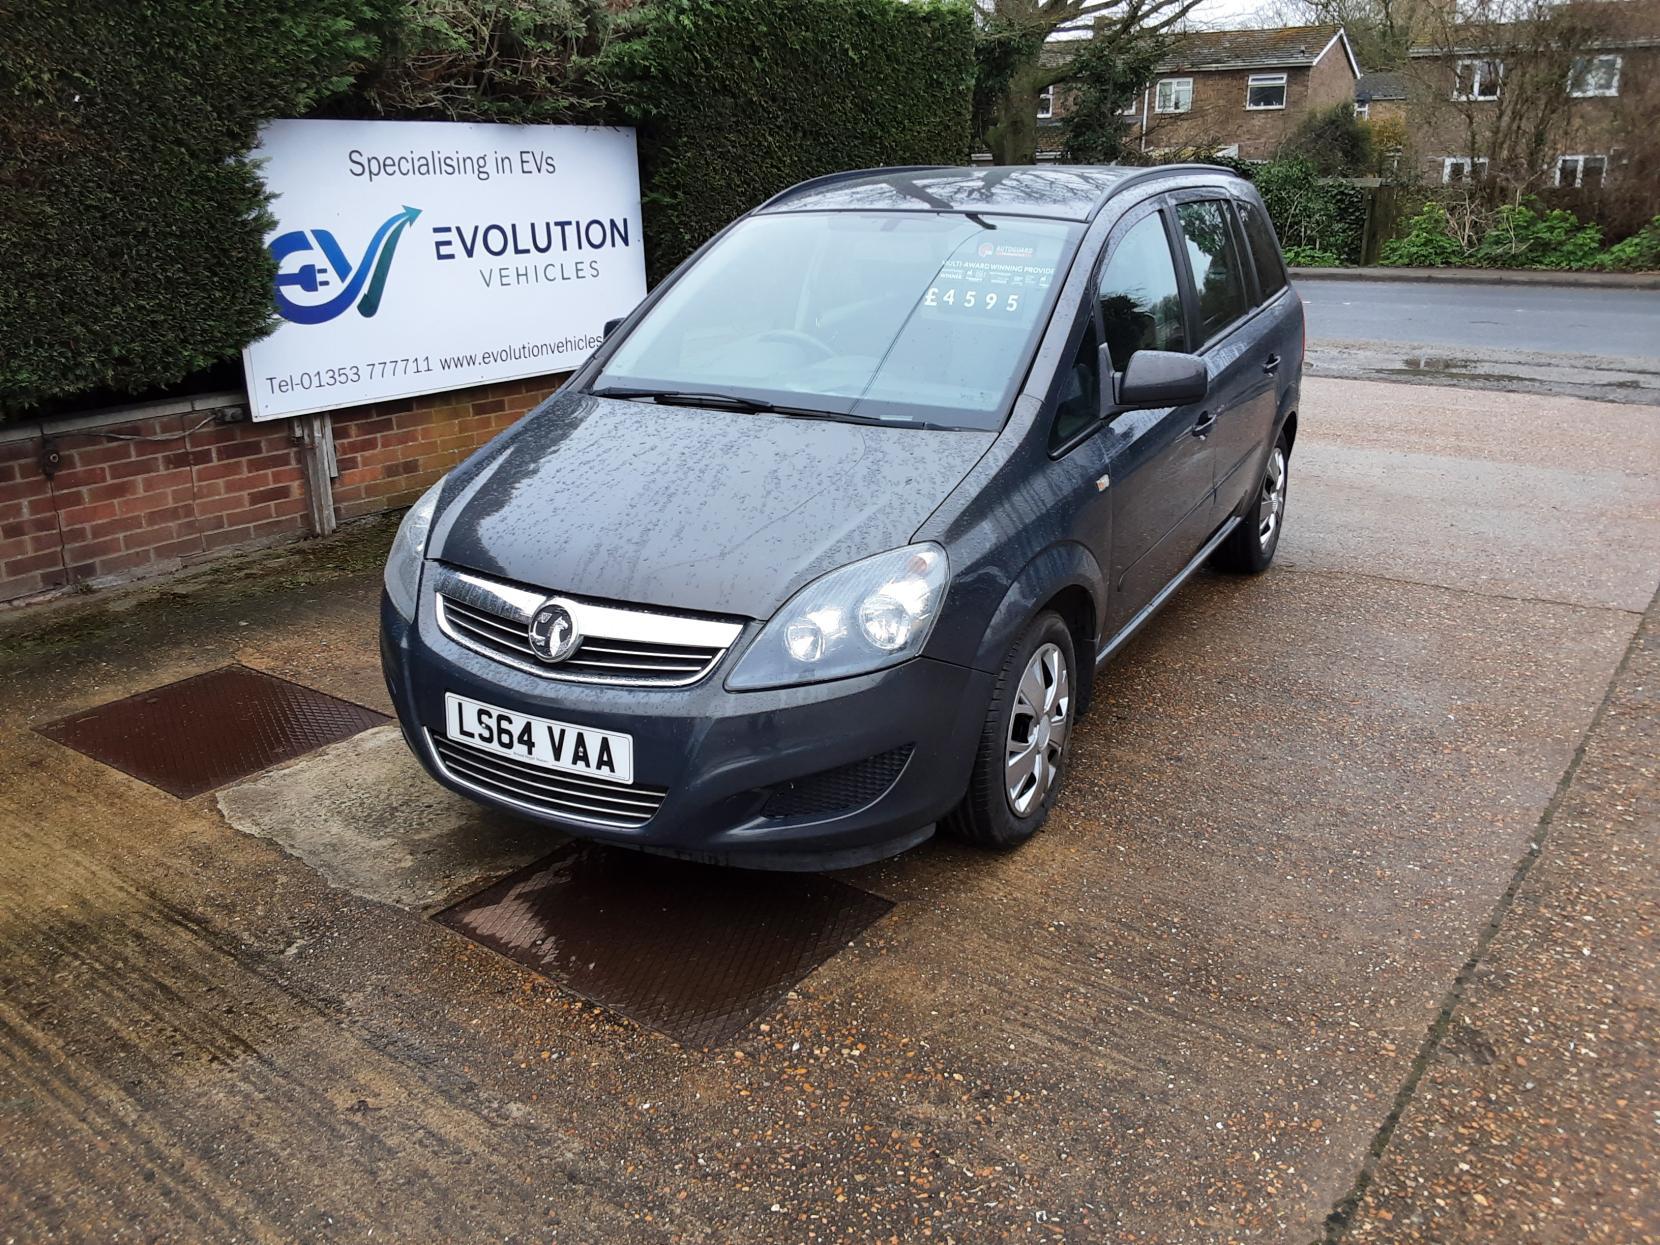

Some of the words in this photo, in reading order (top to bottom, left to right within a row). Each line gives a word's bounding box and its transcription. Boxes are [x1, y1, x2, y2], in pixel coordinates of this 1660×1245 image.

[348, 149, 489, 182] Specialising
[495, 151, 513, 175] in
[520, 150, 556, 175] EVs
[432, 218, 630, 261] EVOLUTION
[479, 260, 600, 288] VEHICLES
[964, 261, 990, 270] AWARD
[990, 263, 1023, 273] WINNING
[266, 365, 361, 395] Tel-01353
[366, 356, 433, 380] 777711
[439, 333, 603, 371] www.evolutionvehicles
[458, 701, 535, 756] LS64
[547, 725, 616, 774] VAA
